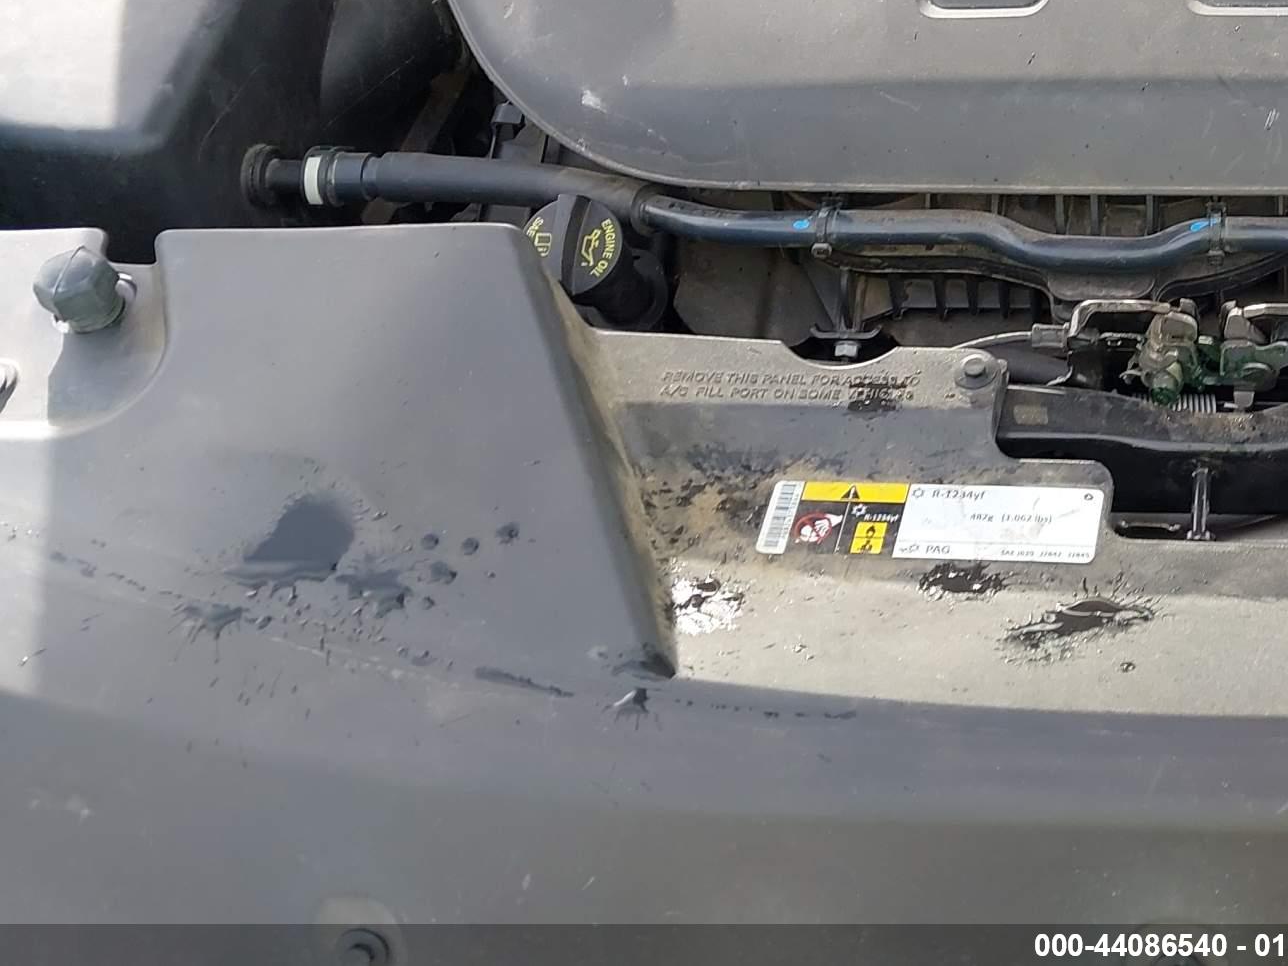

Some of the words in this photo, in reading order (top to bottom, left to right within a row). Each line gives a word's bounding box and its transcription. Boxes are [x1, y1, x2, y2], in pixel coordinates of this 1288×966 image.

[601, 218, 616, 259] ENGINE
[590, 260, 608, 277] OIL
[662, 371, 724, 383] REMOVE
[727, 372, 758, 384] THIS
[761, 373, 807, 386] PANEL
[810, 374, 841, 386] FOR
[660, 385, 688, 397] A/C
[695, 386, 724, 398] FILL
[730, 387, 768, 399] PORT
[773, 389, 796, 400] ON
[797, 389, 842, 400] SOME
[931, 489, 986, 501] R-1234yf
[925, 545, 950, 554] PAG
